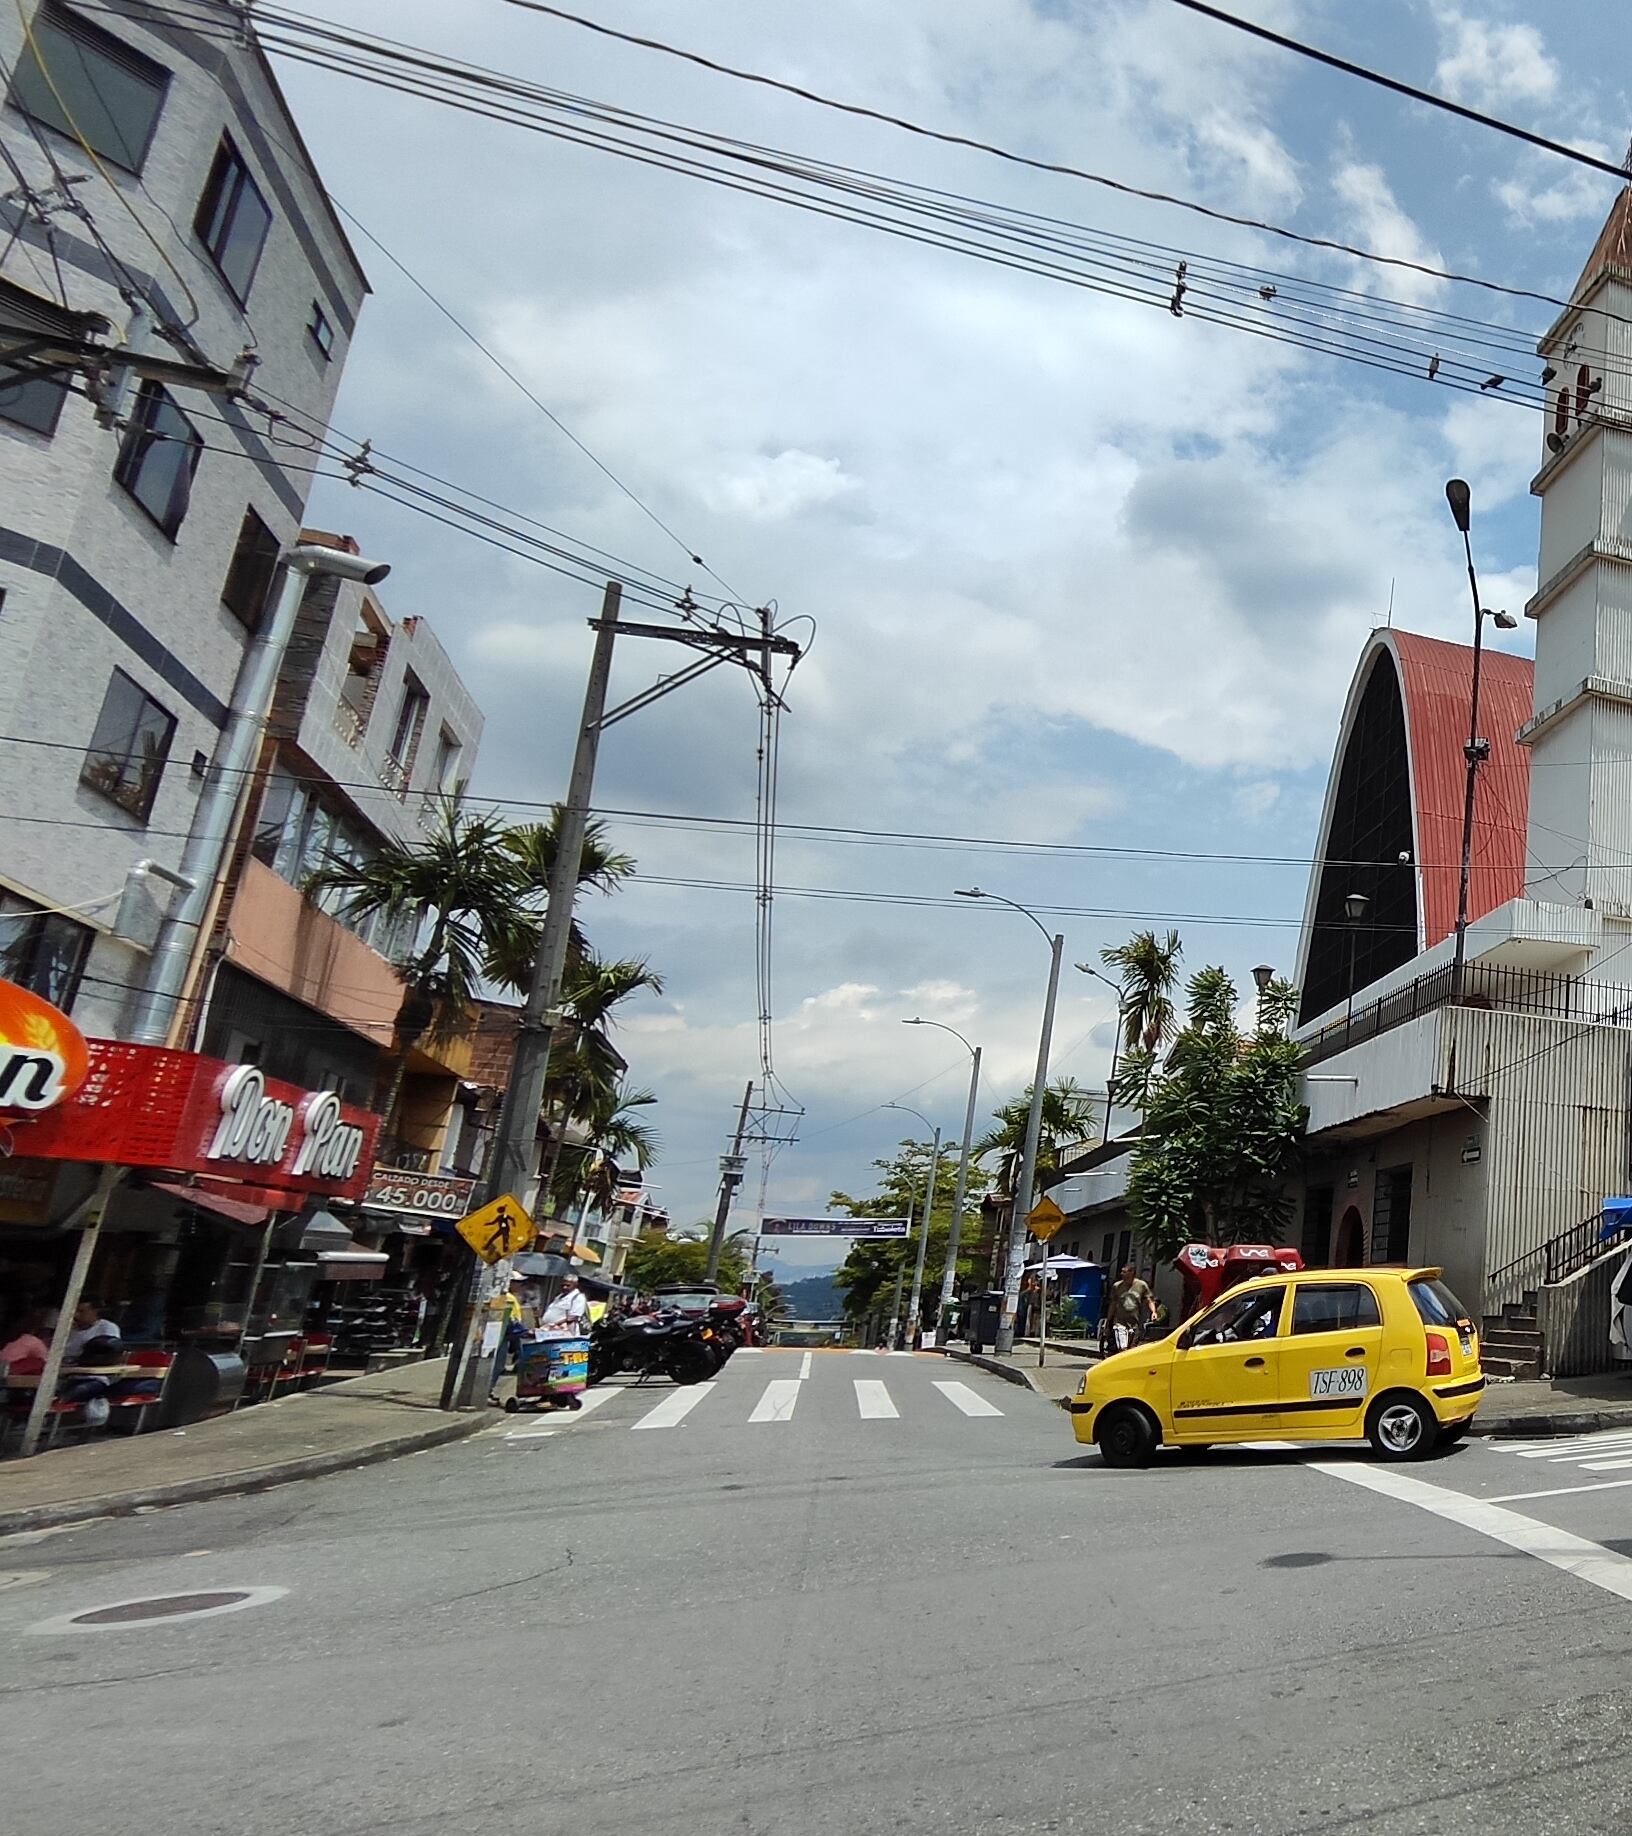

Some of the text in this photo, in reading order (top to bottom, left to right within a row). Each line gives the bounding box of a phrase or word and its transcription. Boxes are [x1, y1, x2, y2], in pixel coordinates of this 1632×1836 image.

[207, 1064, 364, 1178] Don Pan
[373, 1172, 419, 1186] CALZADO
[376, 1186, 457, 1211] 45.000
